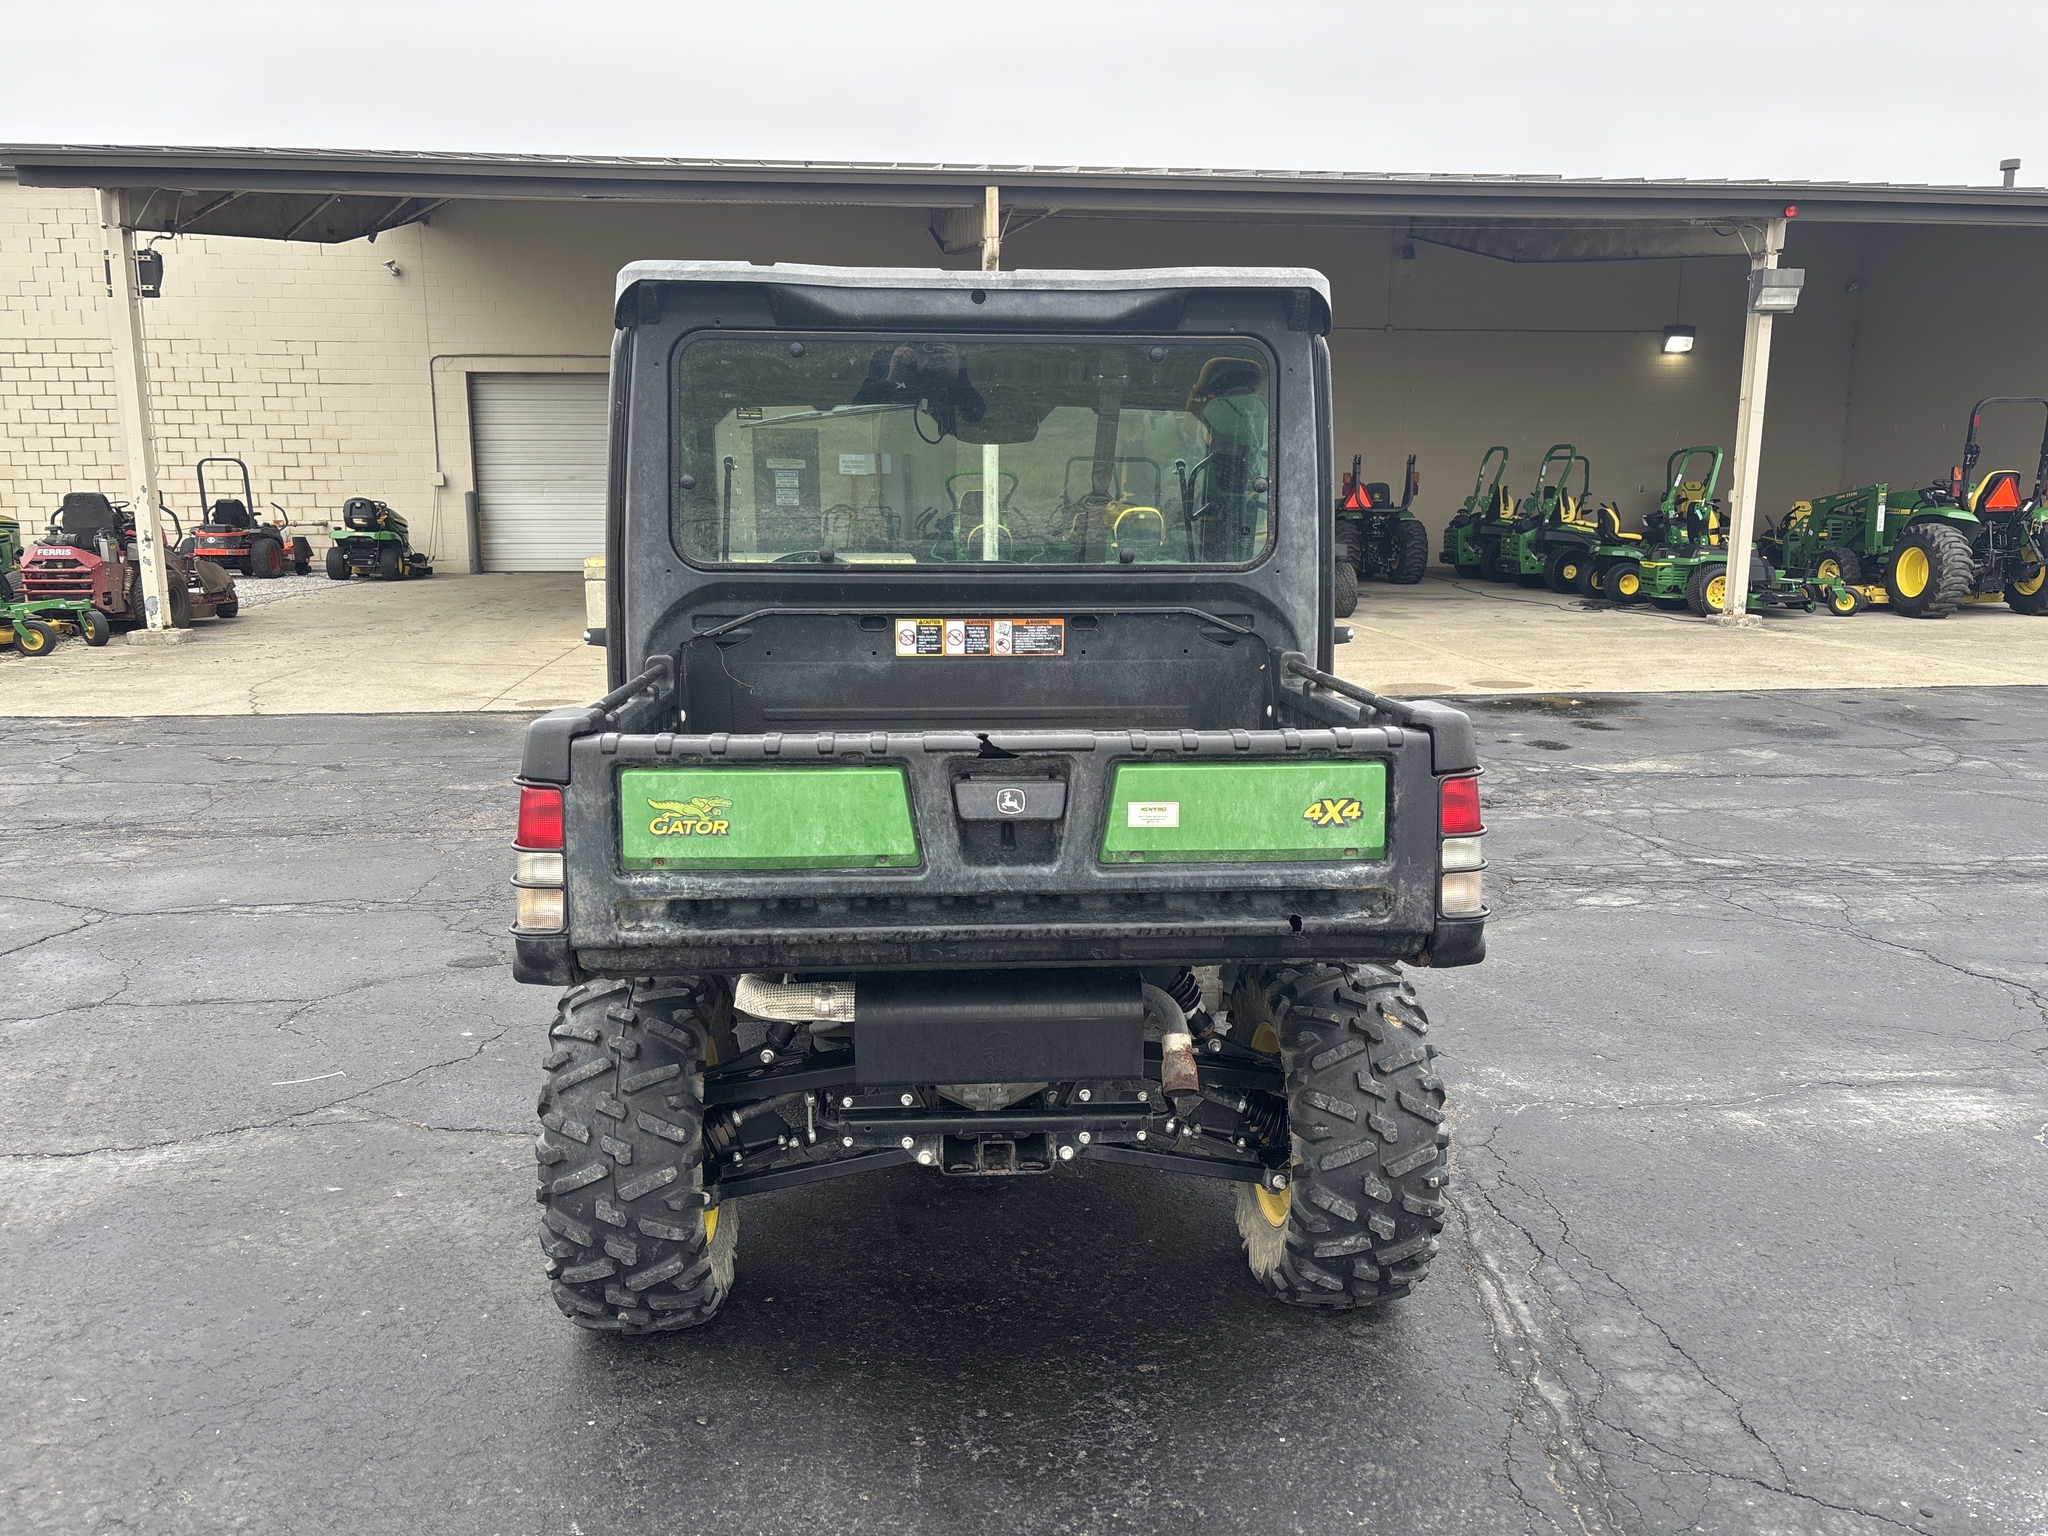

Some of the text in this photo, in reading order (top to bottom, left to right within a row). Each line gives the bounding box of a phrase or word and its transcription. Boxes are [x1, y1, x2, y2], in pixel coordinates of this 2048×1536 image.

[37, 548, 72, 556] FERRIS
[1303, 798, 1363, 826] 4X4
[649, 817, 730, 835] GATOR
